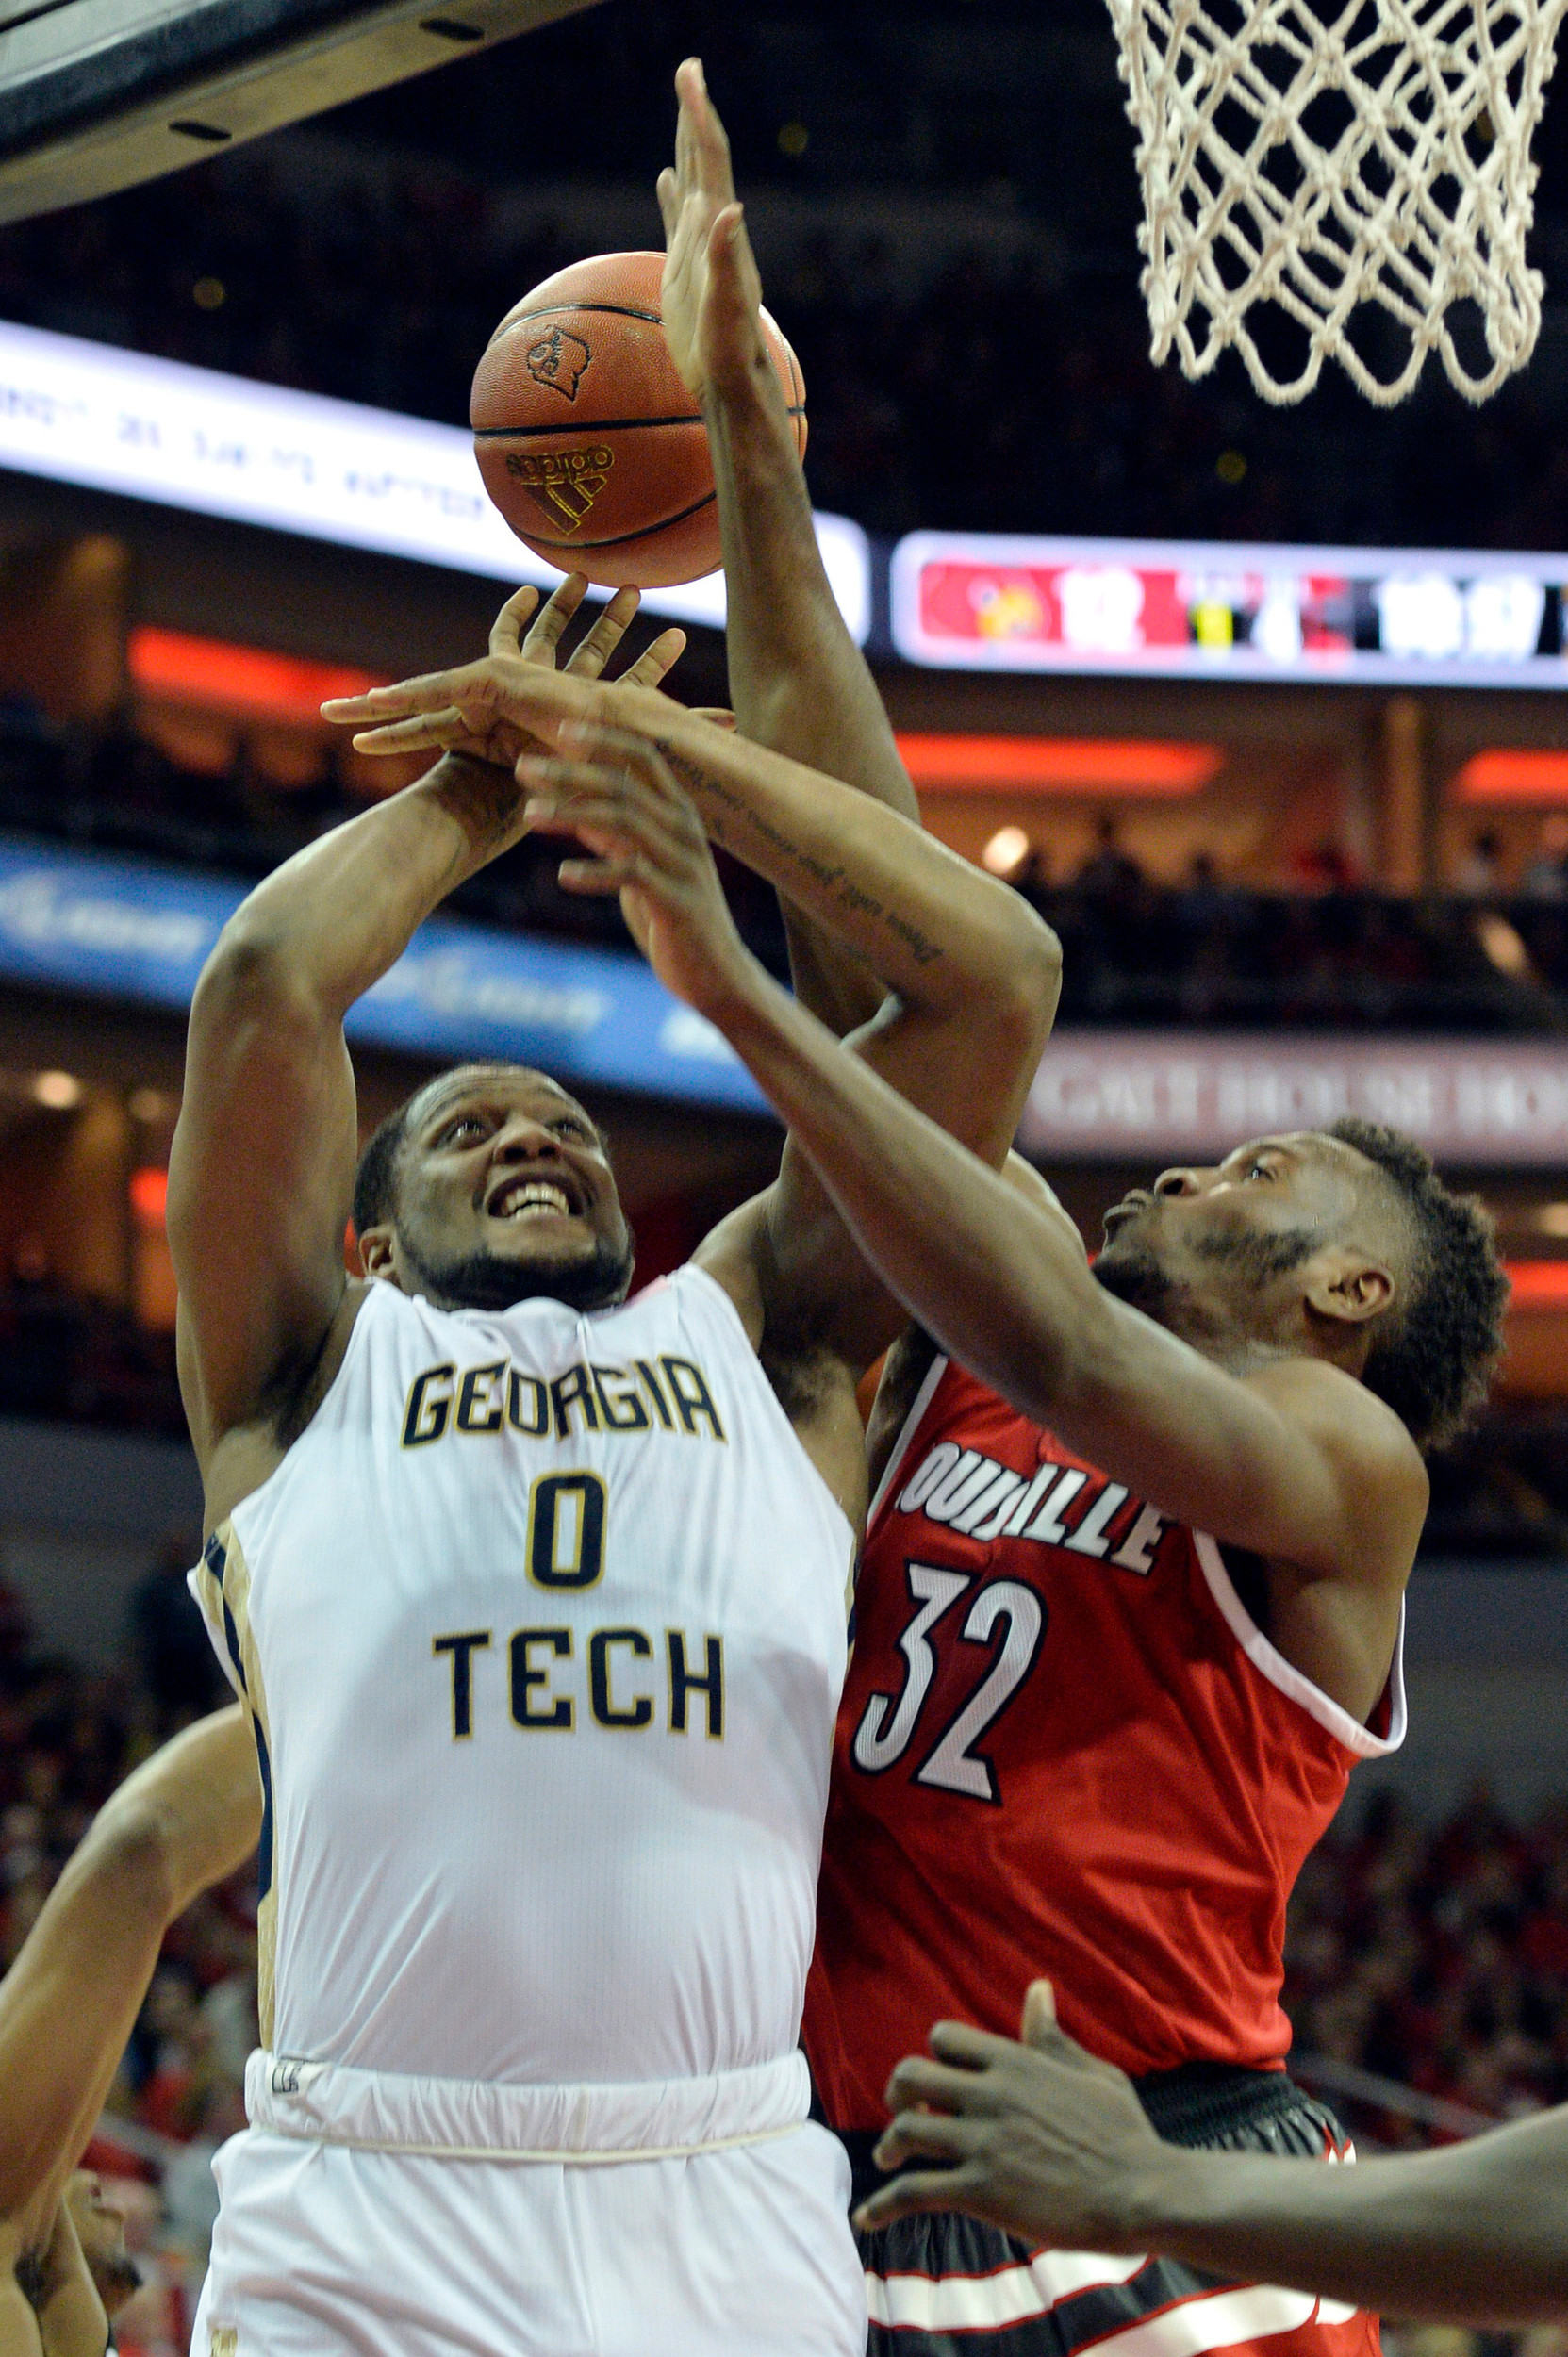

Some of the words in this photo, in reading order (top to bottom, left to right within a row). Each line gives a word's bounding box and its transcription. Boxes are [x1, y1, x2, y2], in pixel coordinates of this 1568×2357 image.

[505, 444, 615, 483] adidas
[401, 1355, 728, 1449] GEORGIA
[525, 1468, 608, 1593] 0
[432, 1624, 726, 1742] TECH
[851, 1559, 1046, 1803] 32
